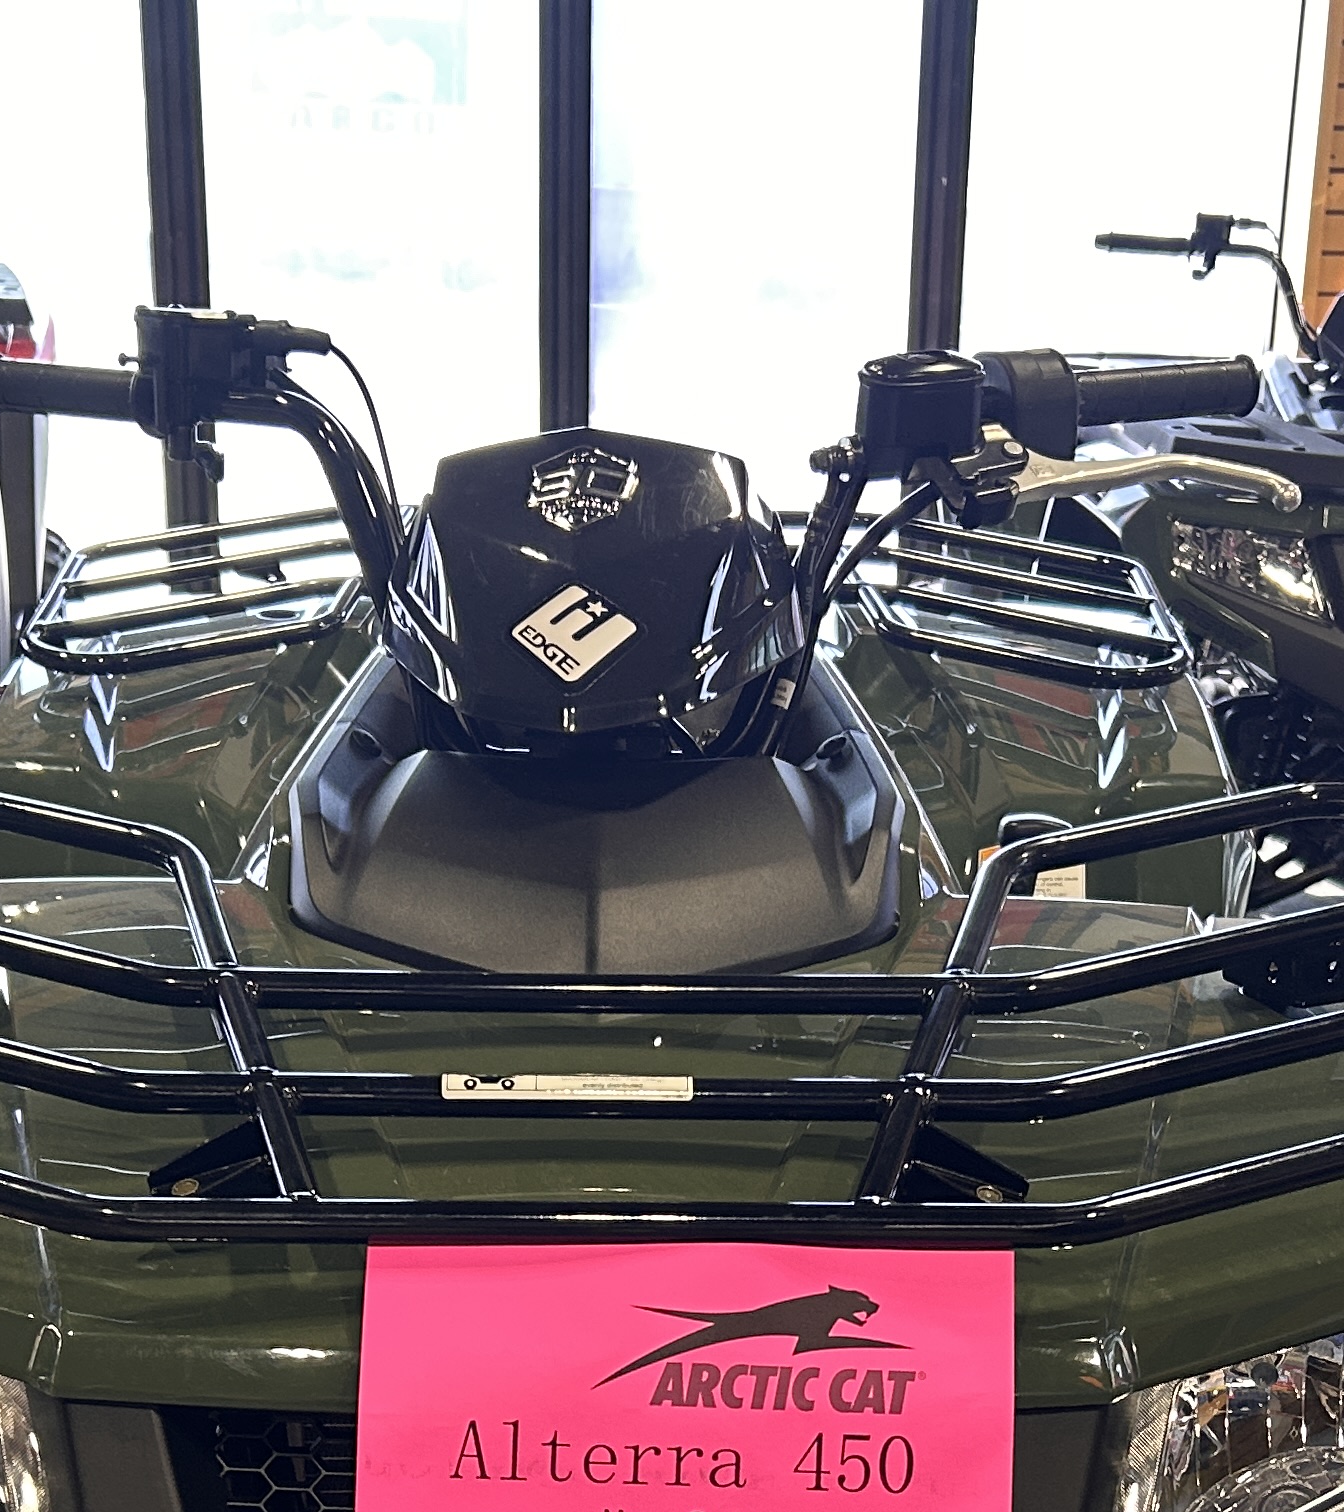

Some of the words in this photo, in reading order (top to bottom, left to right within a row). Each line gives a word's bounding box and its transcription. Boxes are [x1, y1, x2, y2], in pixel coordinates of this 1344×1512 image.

[518, 625, 580, 675] EDGE
[649, 1362, 821, 1411] ARCTIC
[829, 1368, 916, 1415] CAT
[449, 1419, 747, 1489] Alterra
[793, 1432, 914, 1494] 450
